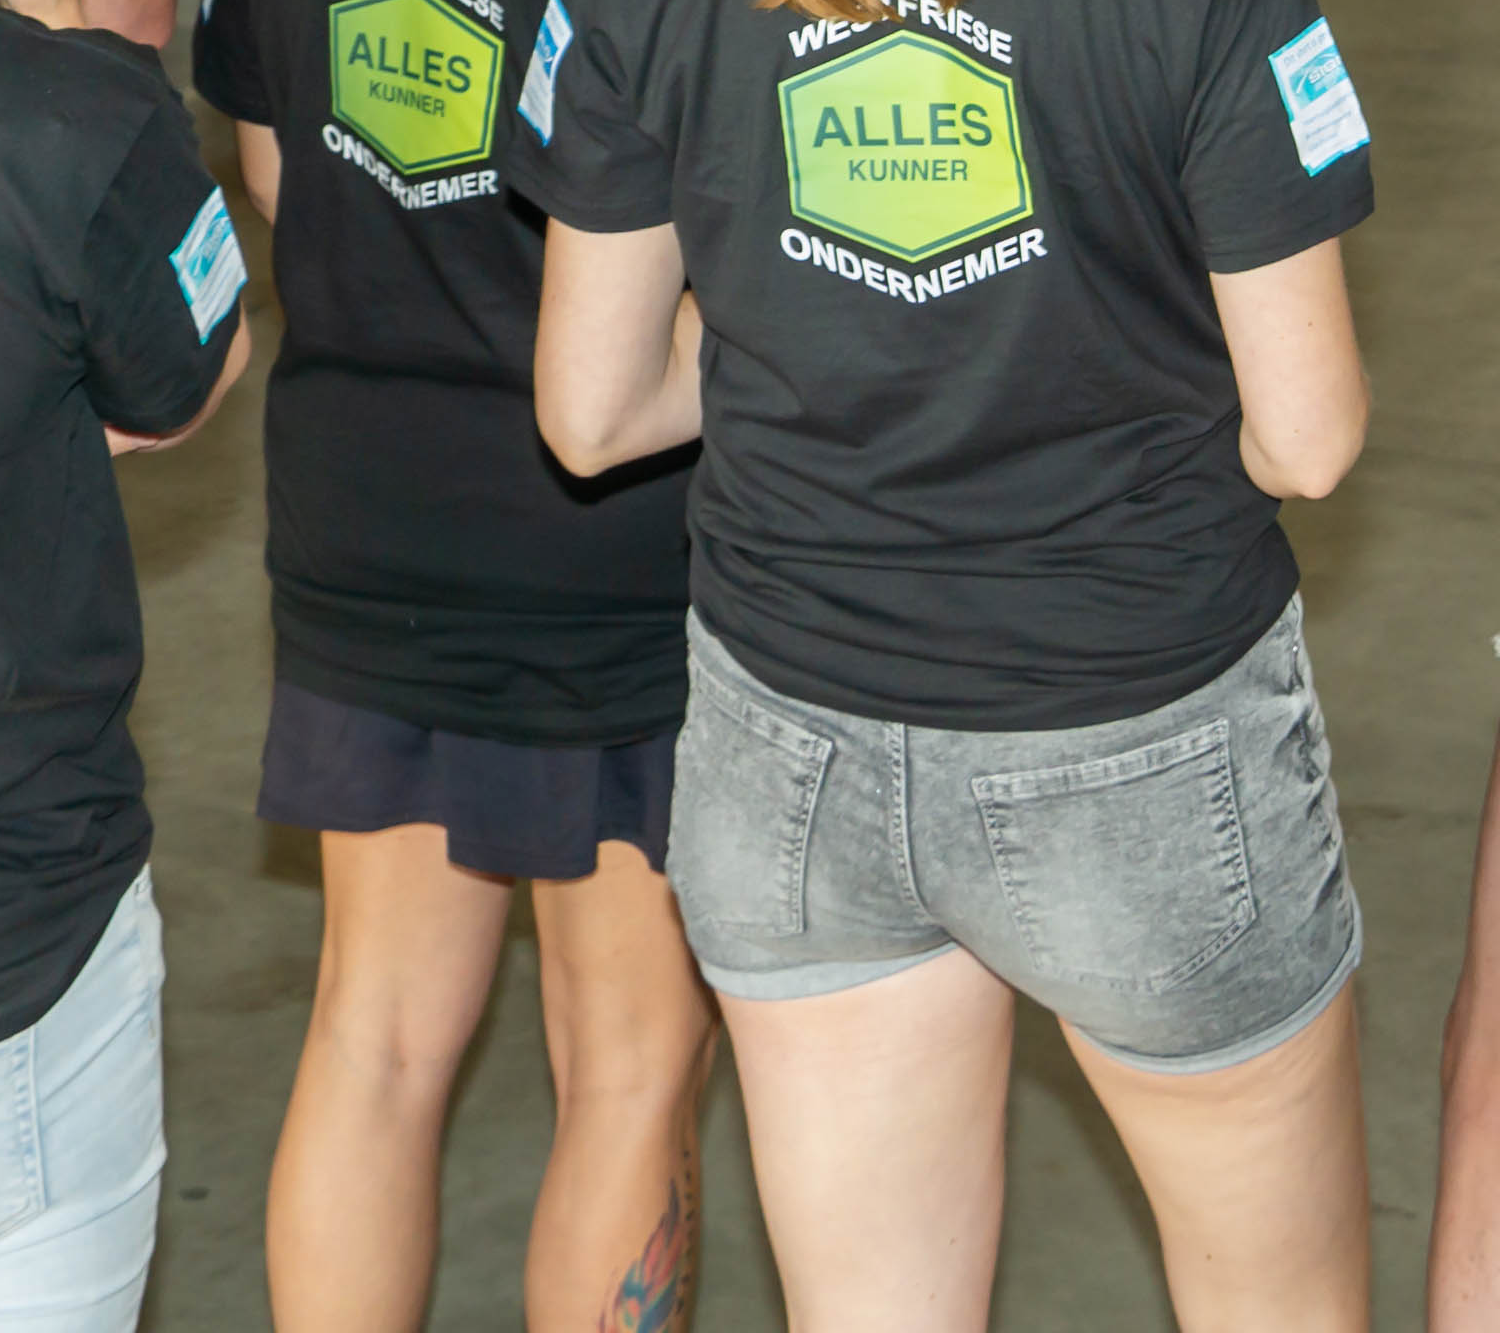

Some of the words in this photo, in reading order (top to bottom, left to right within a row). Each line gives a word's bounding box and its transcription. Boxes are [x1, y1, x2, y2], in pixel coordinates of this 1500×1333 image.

[347, 32, 474, 94] ALLES
[368, 79, 447, 118] KUNNER
[812, 102, 994, 148] ALLES
[321, 123, 500, 211] ONDERNEMER
[847, 158, 970, 183] KUNNER
[779, 227, 1048, 304] ONDERNEMER
